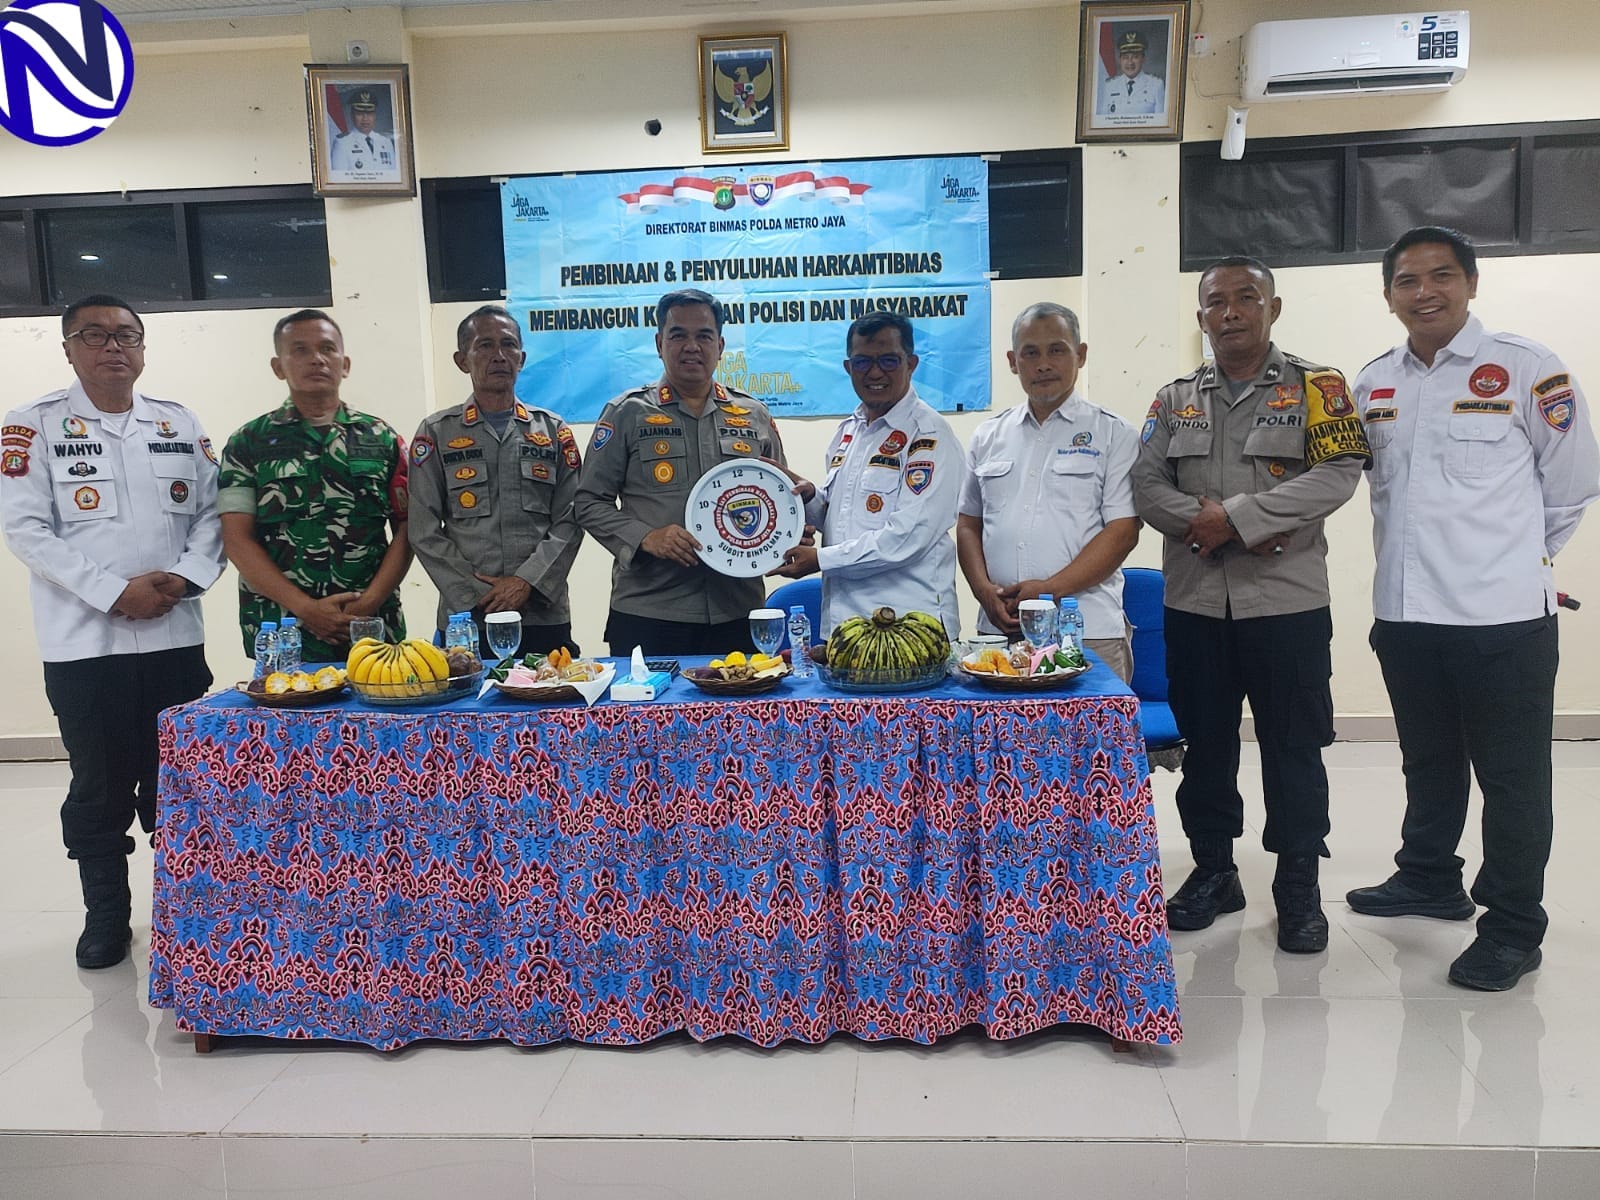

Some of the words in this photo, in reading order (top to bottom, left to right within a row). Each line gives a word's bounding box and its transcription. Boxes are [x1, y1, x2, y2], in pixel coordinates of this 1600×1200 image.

[1420, 15, 1438, 31] 5
[645, 221, 707, 235] DIREKTORAT
[709, 219, 747, 233] BINMAS
[750, 218, 782, 231] POLDA
[785, 217, 818, 230] METRO
[821, 215, 846, 228] JAYA
[560, 261, 659, 288] PEMBINAAN
[664, 260, 677, 282] &
[681, 255, 798, 282] PENYULUHAN
[802, 251, 943, 278] HARKAMTIBMAS
[529, 306, 639, 332] MEMBANGUN
[749, 301, 805, 324] POLISI
[810, 299, 845, 322] DAN
[1256, 414, 1302, 427] POLRI
[3, 426, 34, 437] POLDA
[720, 427, 758, 439] POLRI
[54, 443, 103, 457] WAHYU
[732, 469, 744, 478] 12
[759, 472, 763, 480] 1
[712, 480, 722, 489] 11
[778, 484, 785, 492] 2
[699, 500, 709, 509] 10
[790, 507, 796, 515] 3
[696, 523, 702, 532] 9
[786, 530, 792, 538] 4
[718, 541, 744, 558] SUBDIT
[746, 530, 782, 558] BINPOLMAS
[707, 545, 713, 553] 8
[773, 551, 779, 559] 5
[727, 559, 733, 567] 7
[751, 561, 757, 569] 6
